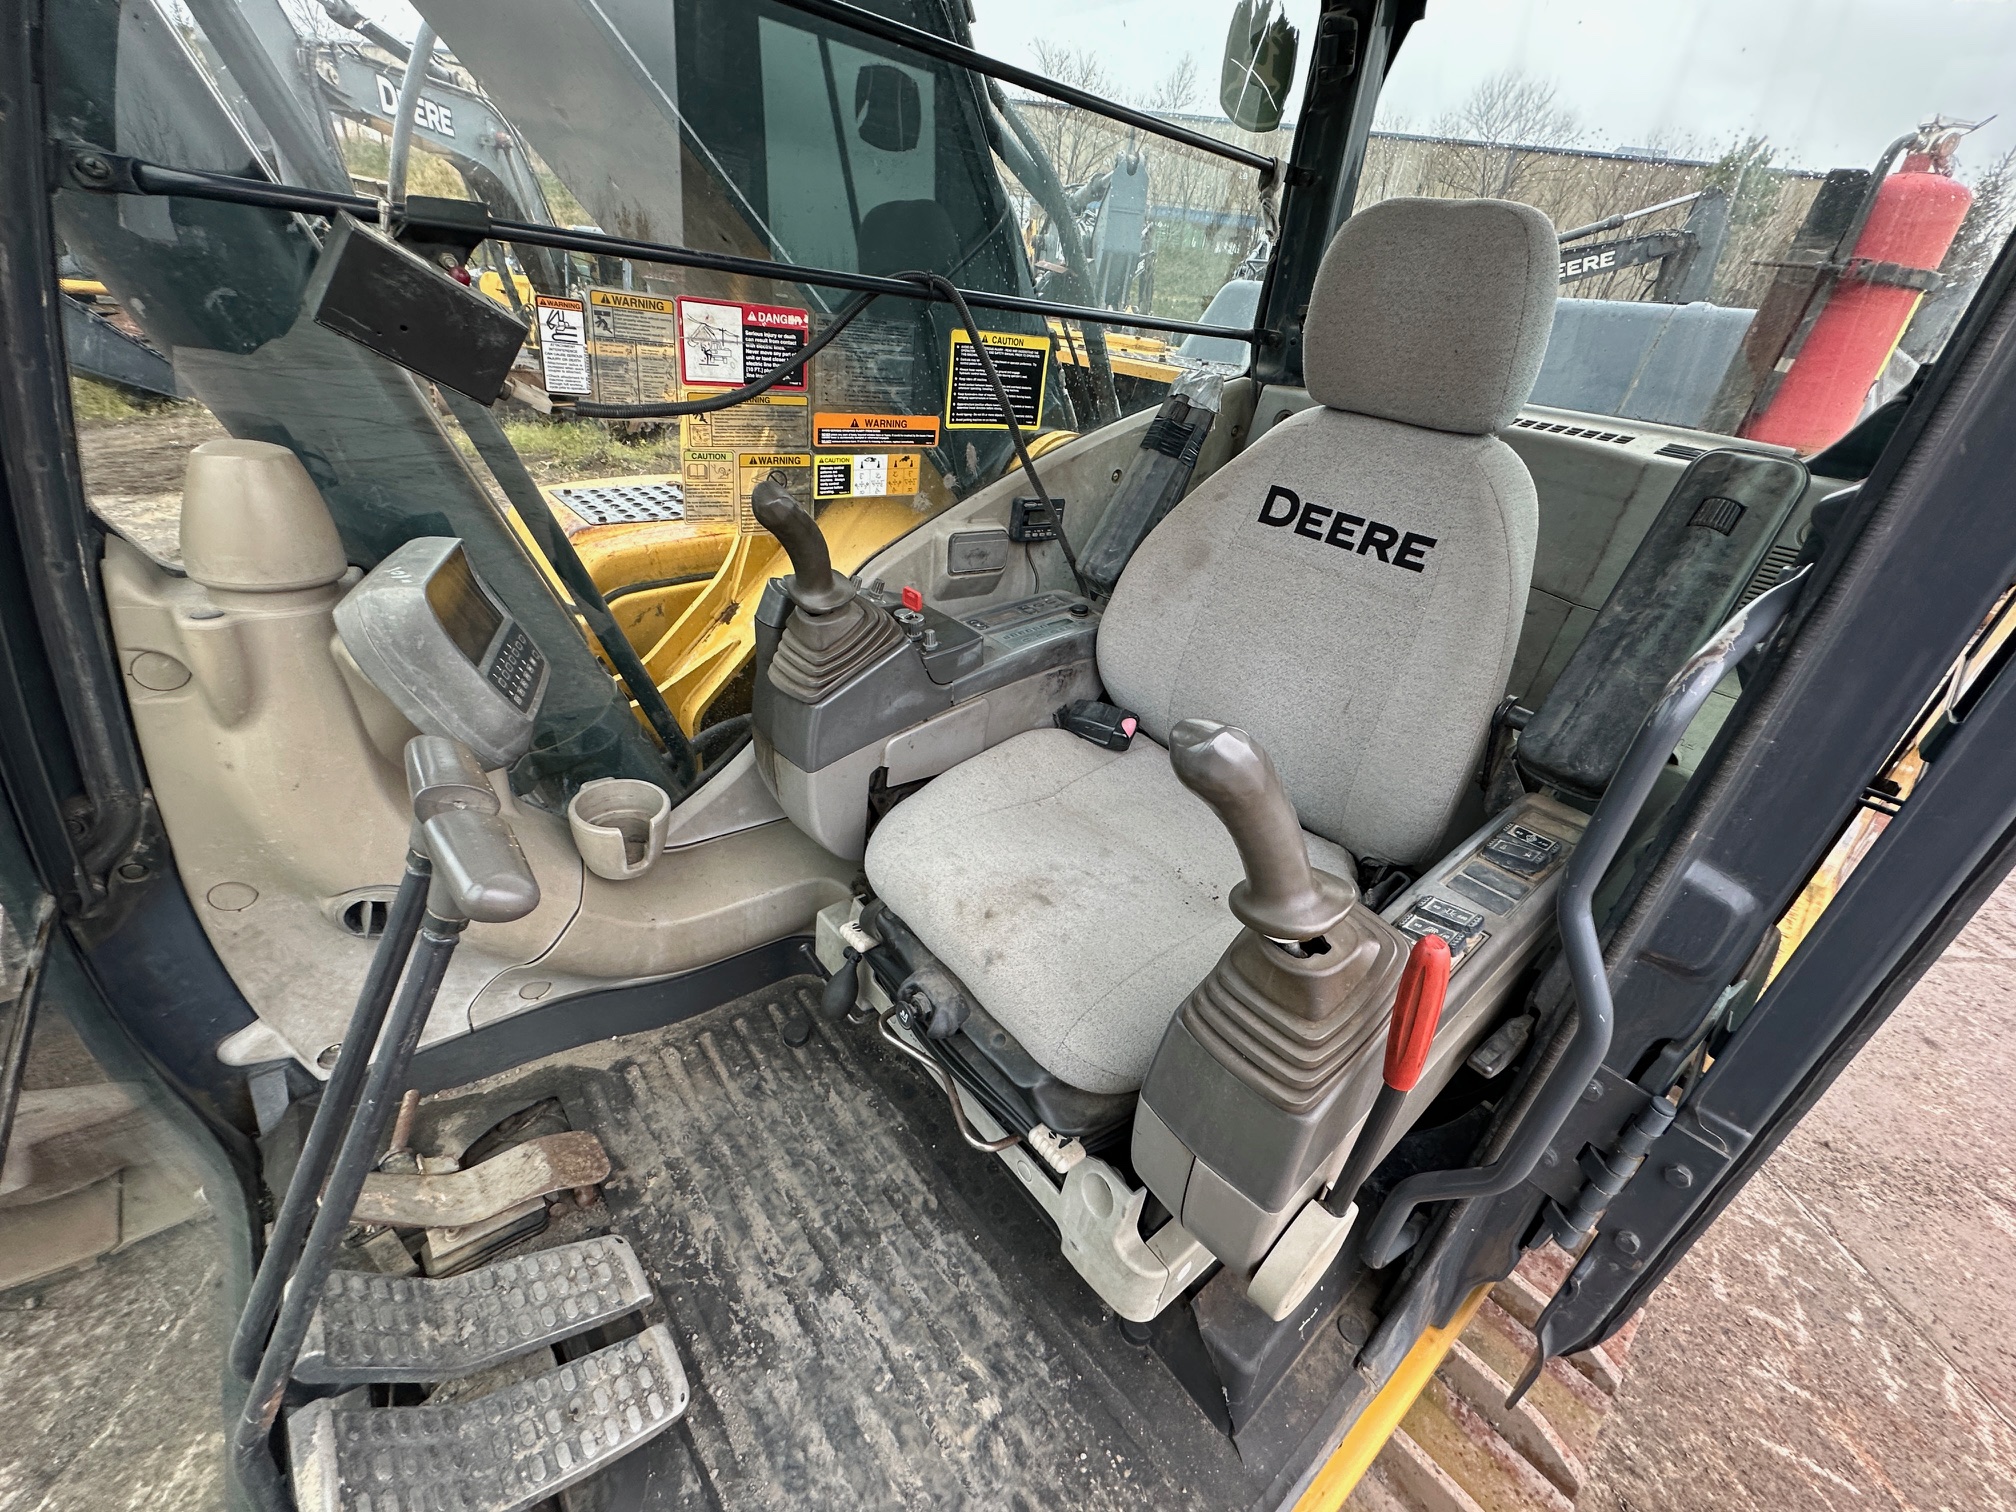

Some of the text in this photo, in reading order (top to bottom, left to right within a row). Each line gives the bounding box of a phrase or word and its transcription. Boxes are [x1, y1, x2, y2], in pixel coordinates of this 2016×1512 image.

[376, 74, 455, 137] DERE
[546, 300, 580, 309] WARNING
[611, 295, 664, 311] WARNING
[992, 336, 1024, 346] CAUTION
[865, 419, 908, 428] WARNING
[1258, 484, 1438, 573] DEERE
